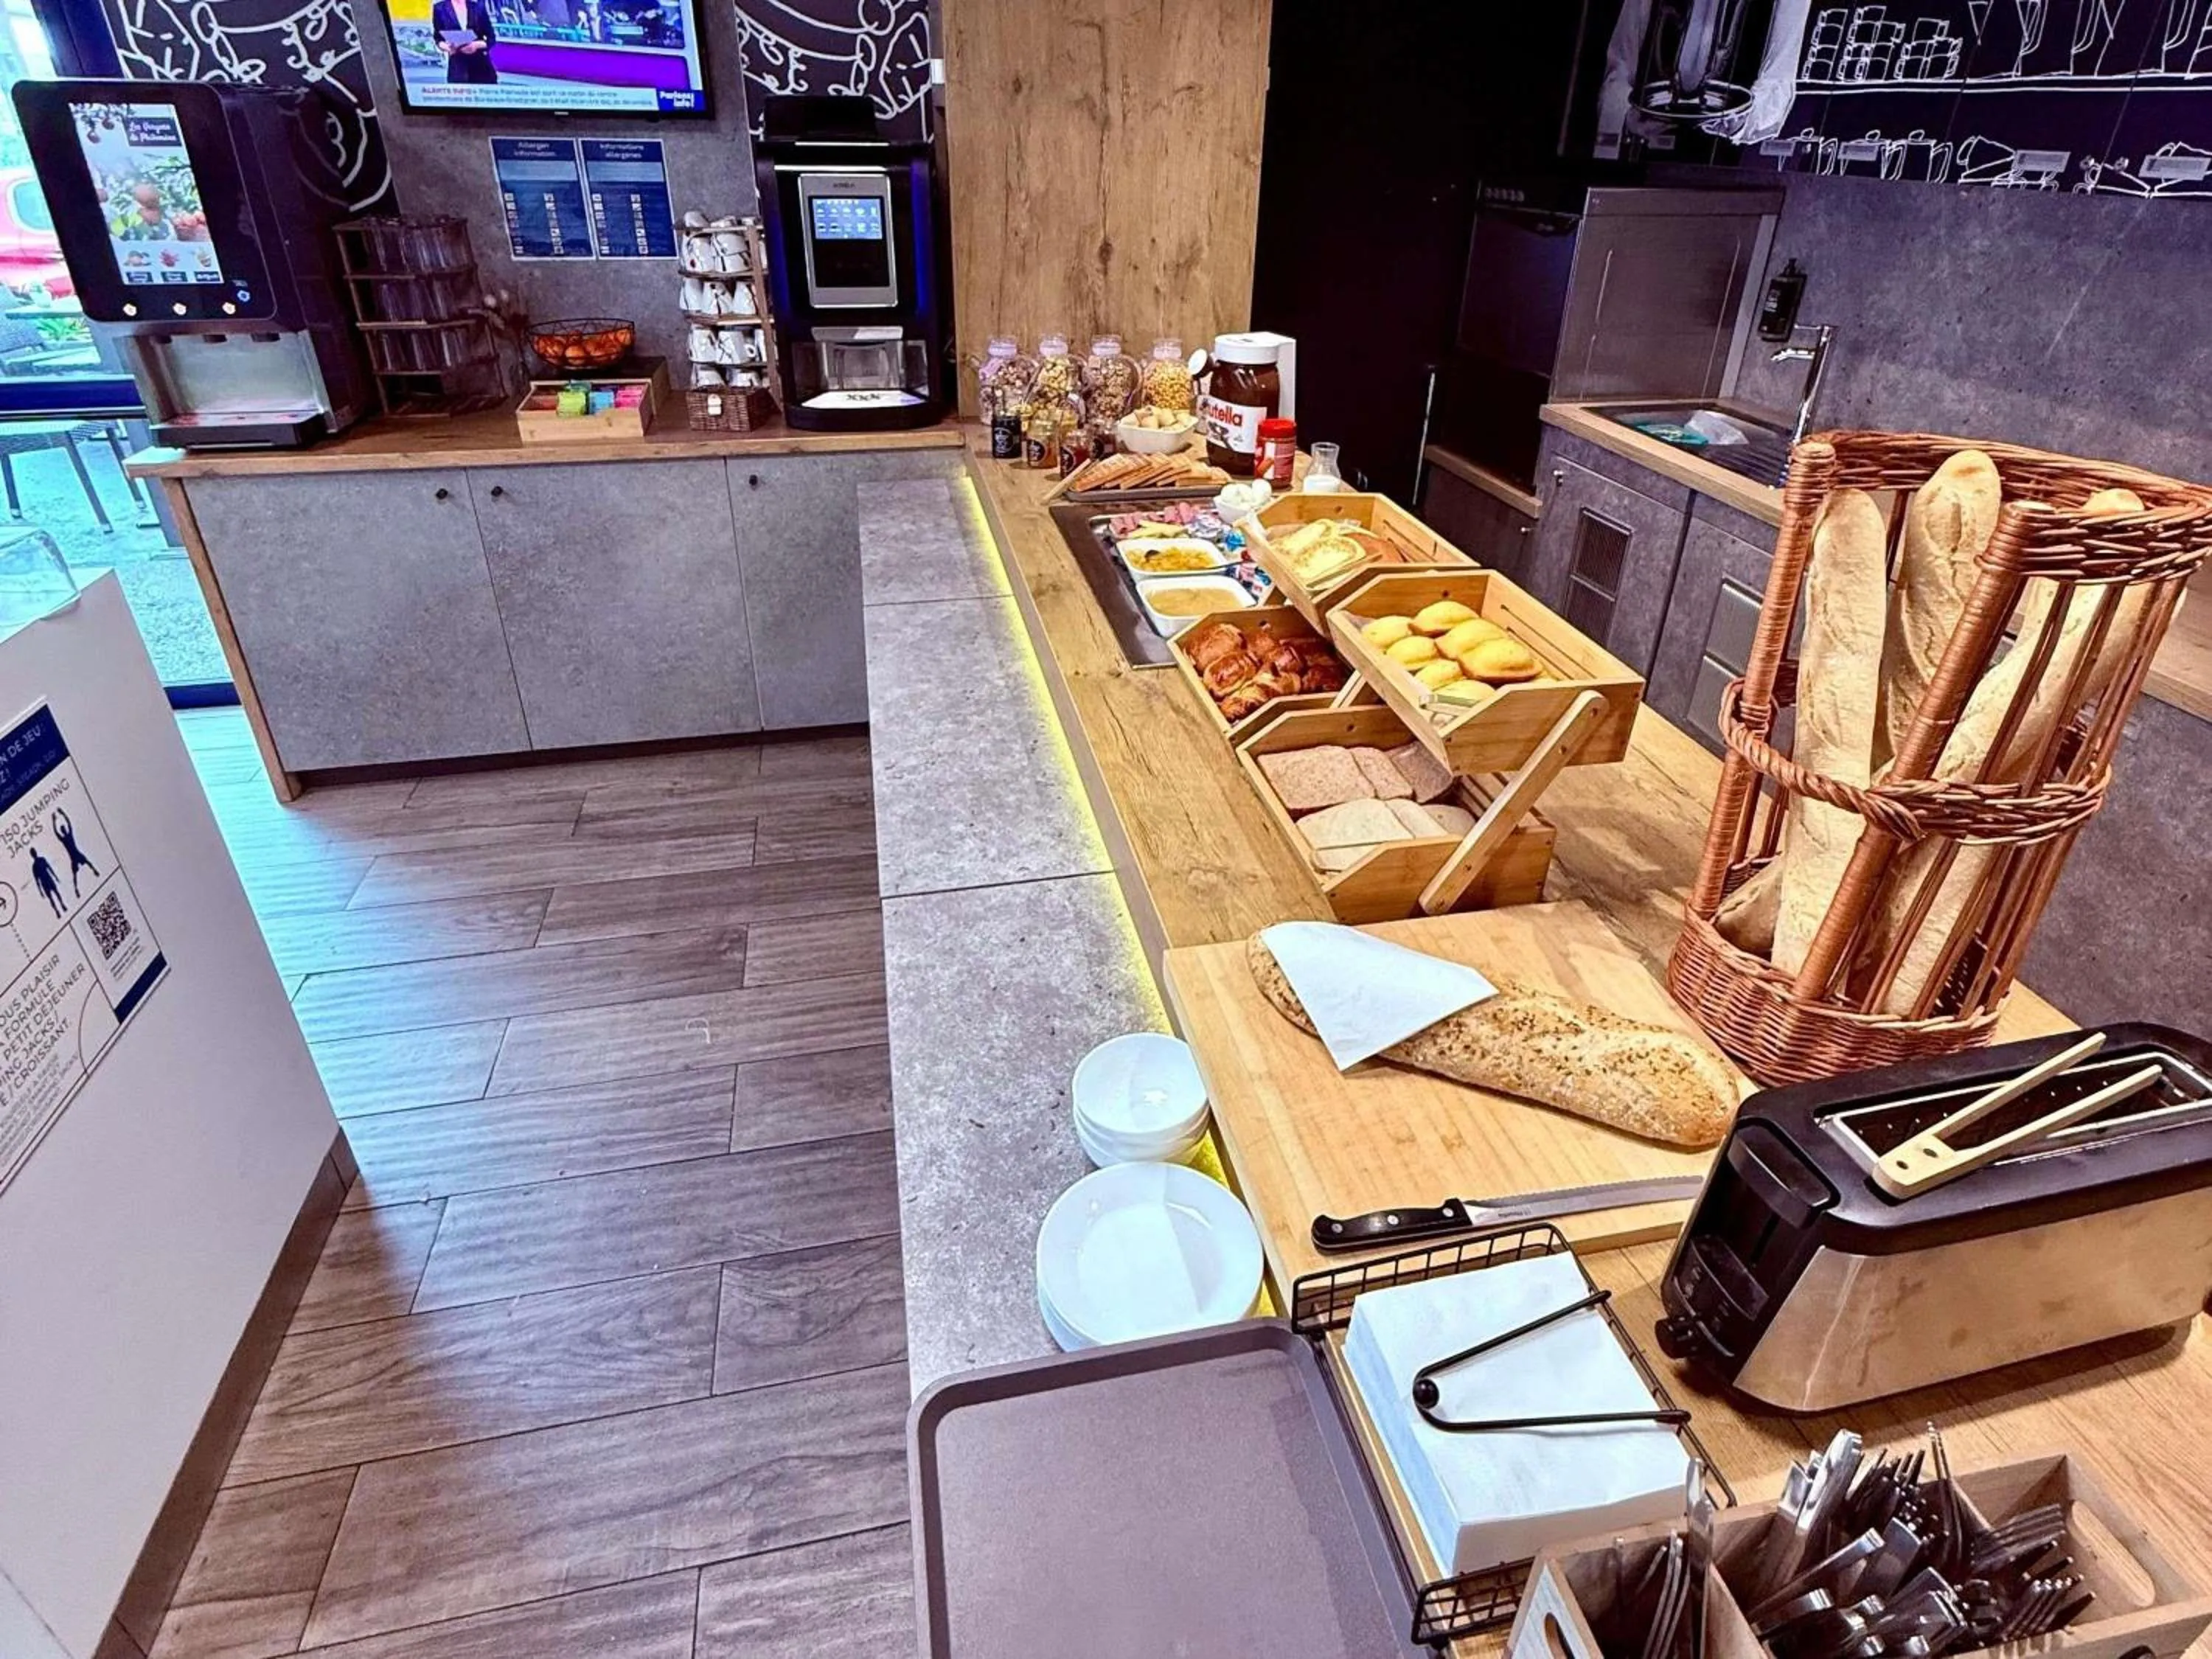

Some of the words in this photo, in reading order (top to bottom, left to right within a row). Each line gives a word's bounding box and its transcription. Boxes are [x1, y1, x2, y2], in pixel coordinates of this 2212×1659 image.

[22, 725, 41, 746] JEU
[19, 778, 70, 827] JUMPING
[7, 820, 44, 858] JACKS
[21, 954, 60, 1001] PLAISIR
[4, 979, 57, 1040] FORMULE
[3, 1023, 33, 1061] PETIT
